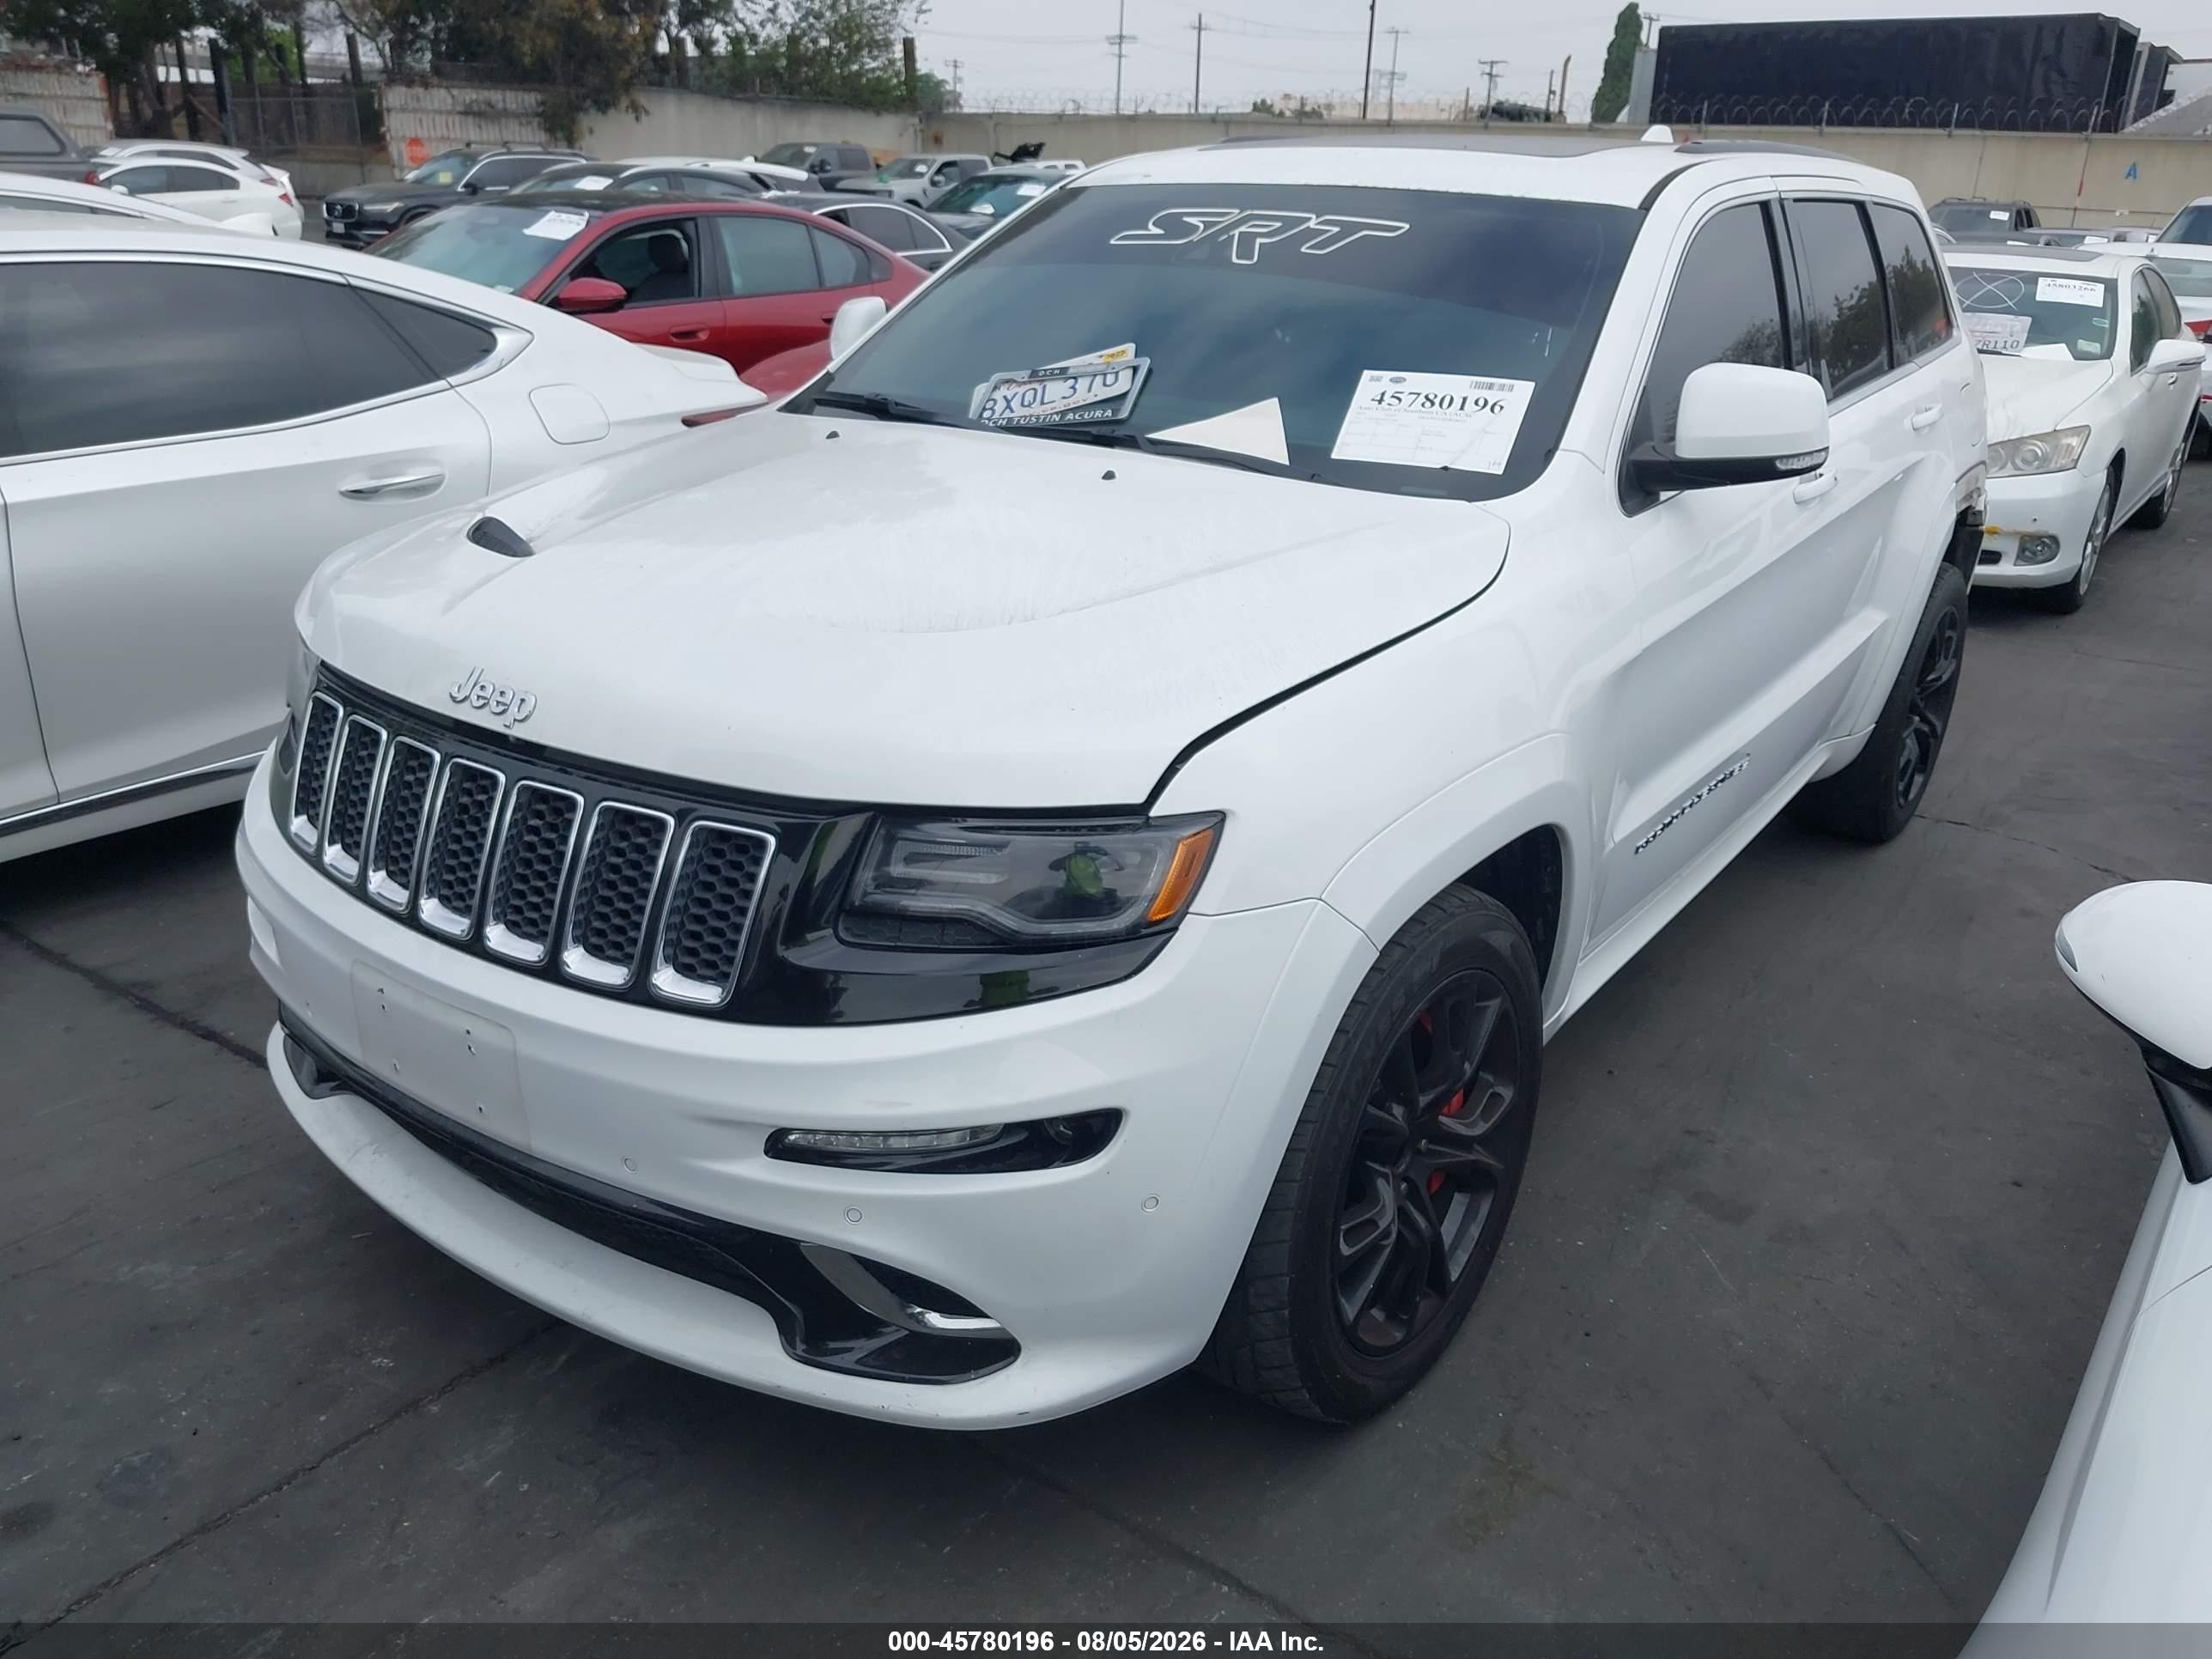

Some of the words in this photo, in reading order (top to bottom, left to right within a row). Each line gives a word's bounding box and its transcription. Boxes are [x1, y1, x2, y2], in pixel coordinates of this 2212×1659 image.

[1109, 207, 1411, 264] SRT
[1037, 368, 1061, 377] DCH
[1370, 389, 1508, 416] 45780196
[1013, 412, 1061, 424] TUSTIN
[1067, 409, 1114, 421] ACURA
[449, 666, 538, 729] Jeep
